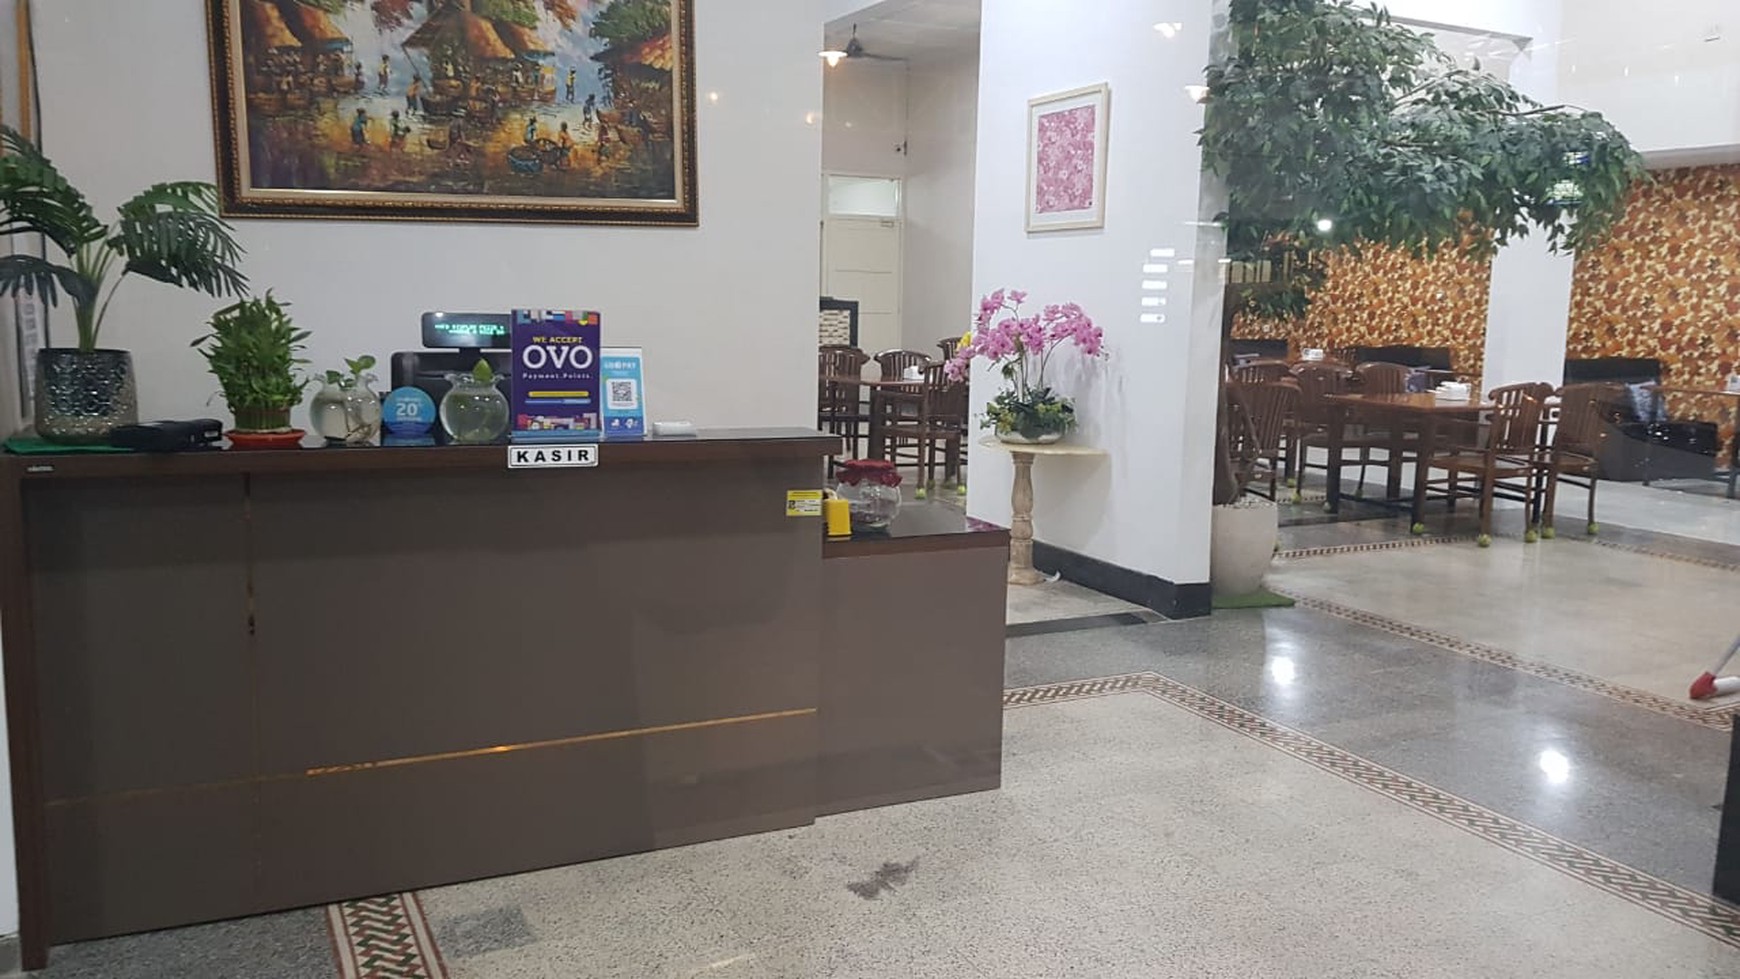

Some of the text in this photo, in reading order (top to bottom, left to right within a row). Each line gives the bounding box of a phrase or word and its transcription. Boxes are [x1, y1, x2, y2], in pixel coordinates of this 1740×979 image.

[522, 344, 593, 369] OVO
[396, 402, 418, 416] 20
[516, 449, 590, 463] KASIR
